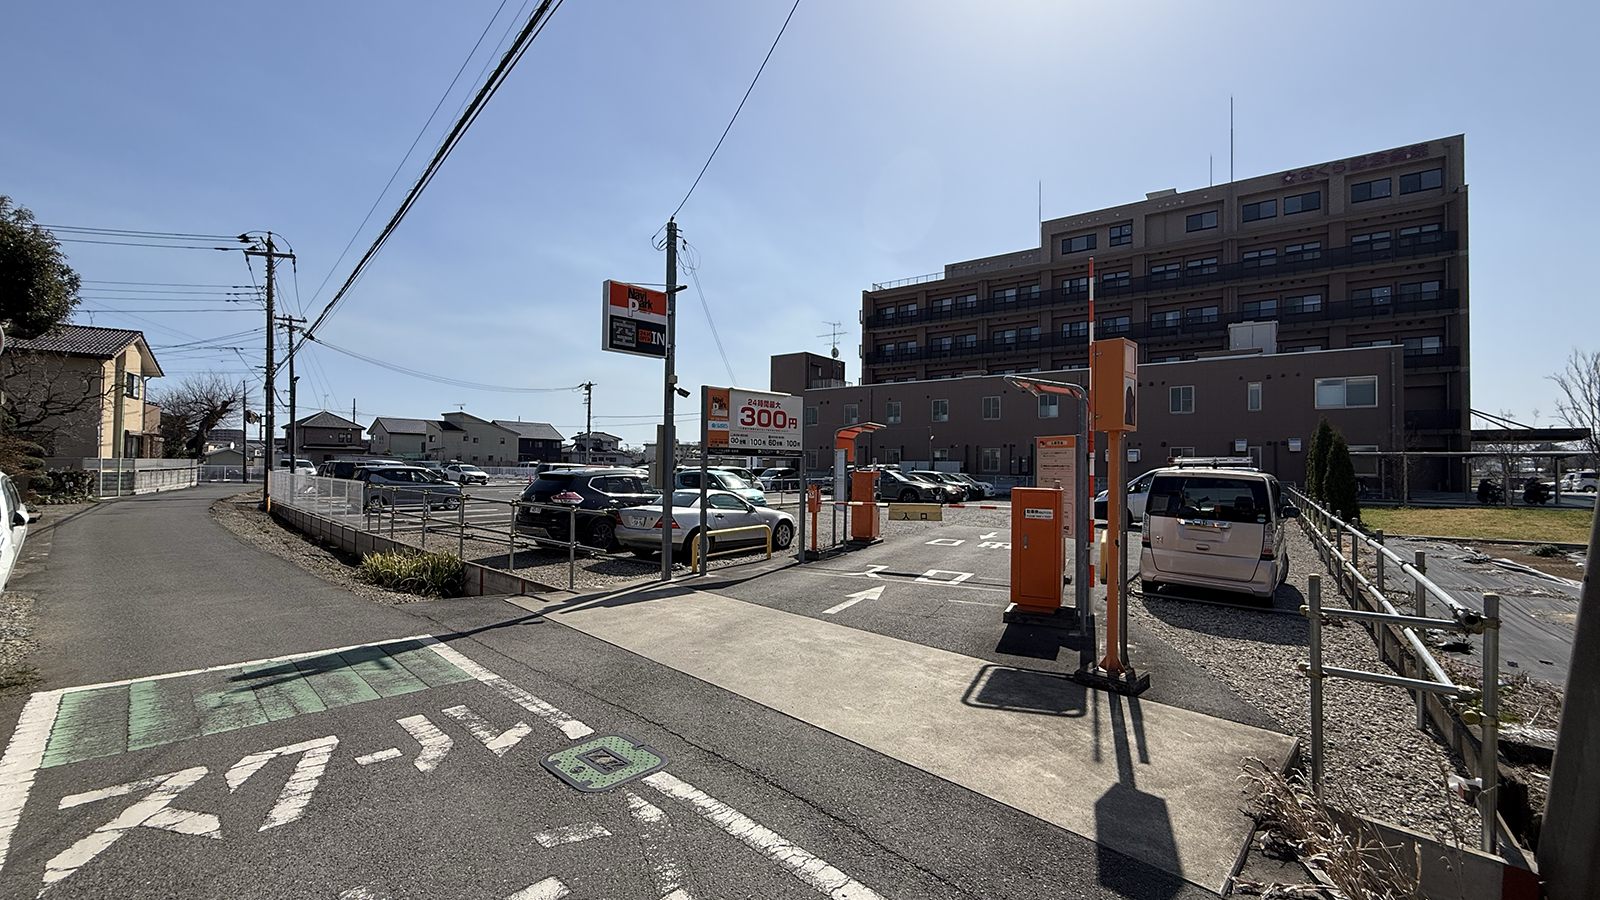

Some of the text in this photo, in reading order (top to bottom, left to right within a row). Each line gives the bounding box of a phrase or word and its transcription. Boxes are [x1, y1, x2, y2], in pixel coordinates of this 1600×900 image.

[627, 288, 647, 300] Navi
[628, 298, 653, 317] Park
[651, 331, 665, 346] IN
[748, 398, 782, 409] 24時間最大
[740, 406, 798, 429] 300円
[903, 512, 927, 520] 入口
[37, 706, 532, 898] スクール
